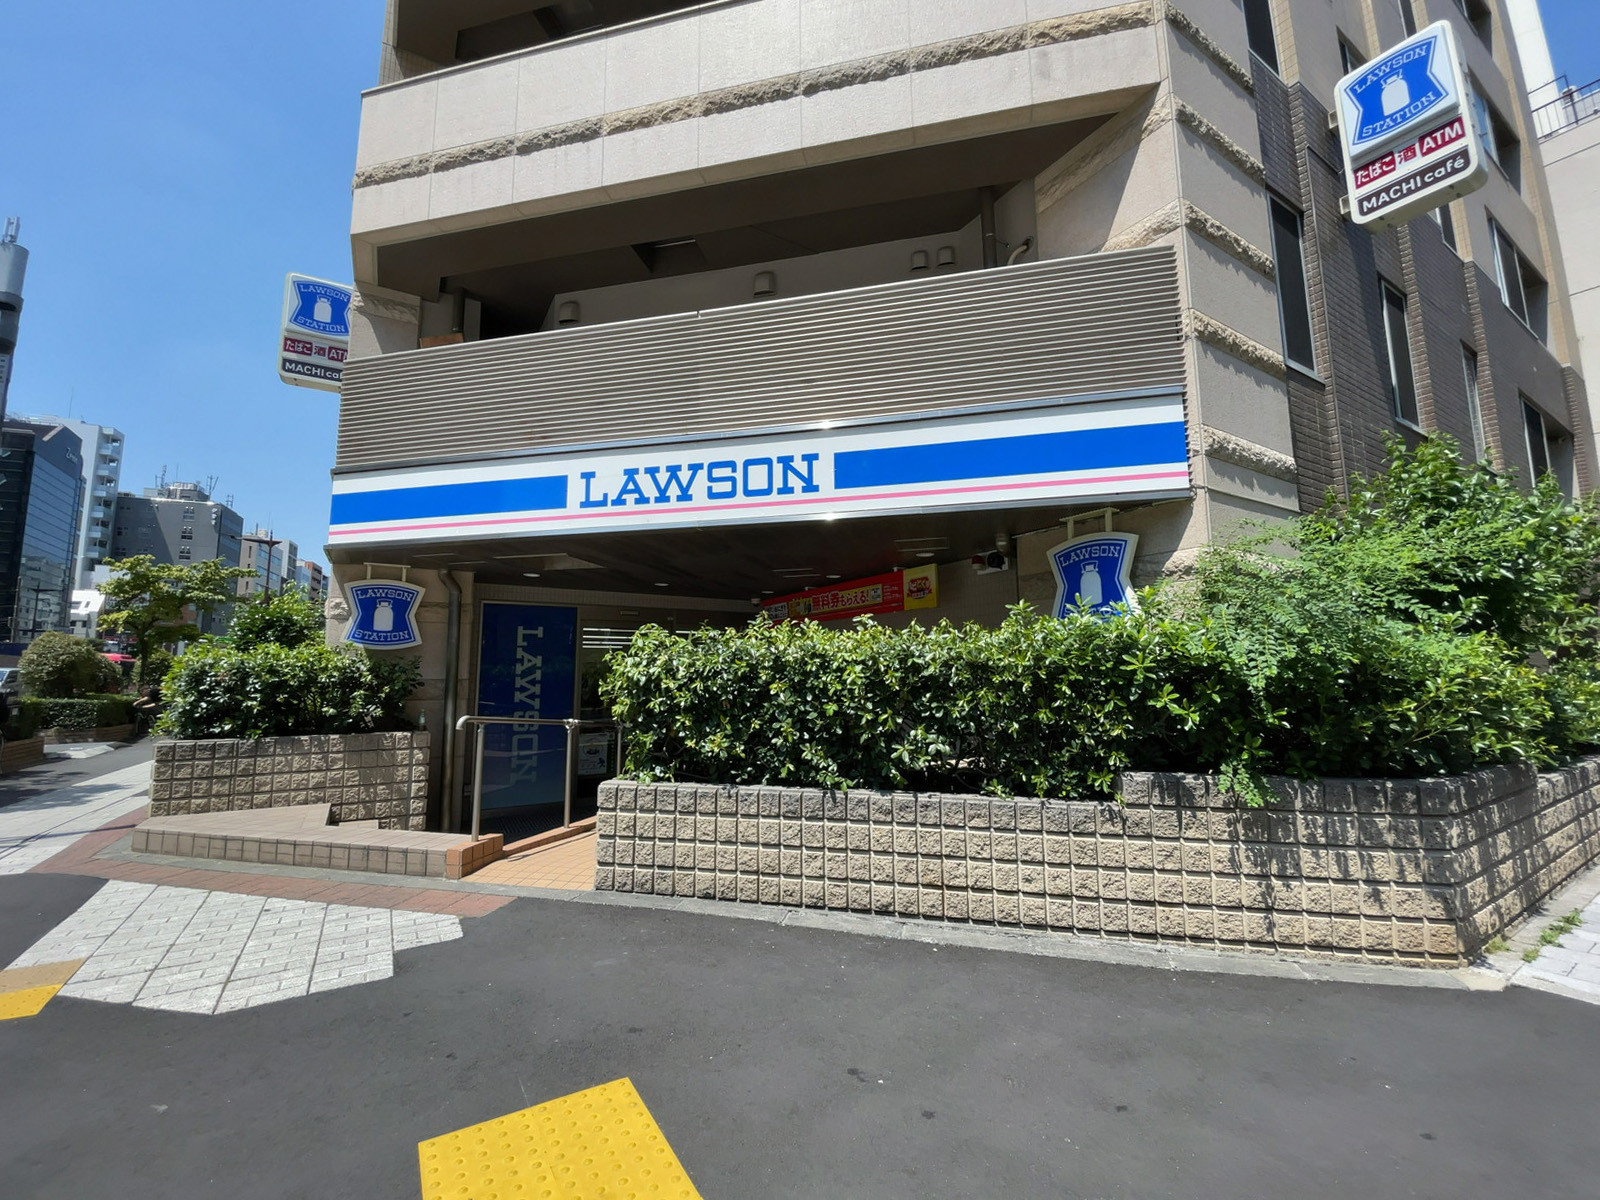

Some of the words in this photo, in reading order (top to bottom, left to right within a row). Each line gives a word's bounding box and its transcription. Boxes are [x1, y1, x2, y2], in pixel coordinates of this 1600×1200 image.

[1353, 44, 1428, 94] LAWSON
[1362, 91, 1437, 137] STATION
[1356, 155, 1395, 185] たばこ
[1422, 122, 1463, 153] ATM
[1362, 176, 1422, 213] MACHI
[1424, 156, 1465, 183] café
[299, 284, 349, 302] LAWSON
[296, 315, 346, 333] STATION
[285, 339, 313, 354] たばこ
[285, 362, 324, 377] MACHI
[326, 370, 342, 379] ca
[579, 453, 819, 508] LAWSON
[1060, 545, 1121, 567] LAWSON
[357, 588, 414, 602] LAWSON
[354, 629, 410, 641] STATION
[510, 625, 544, 785] LAWSON
